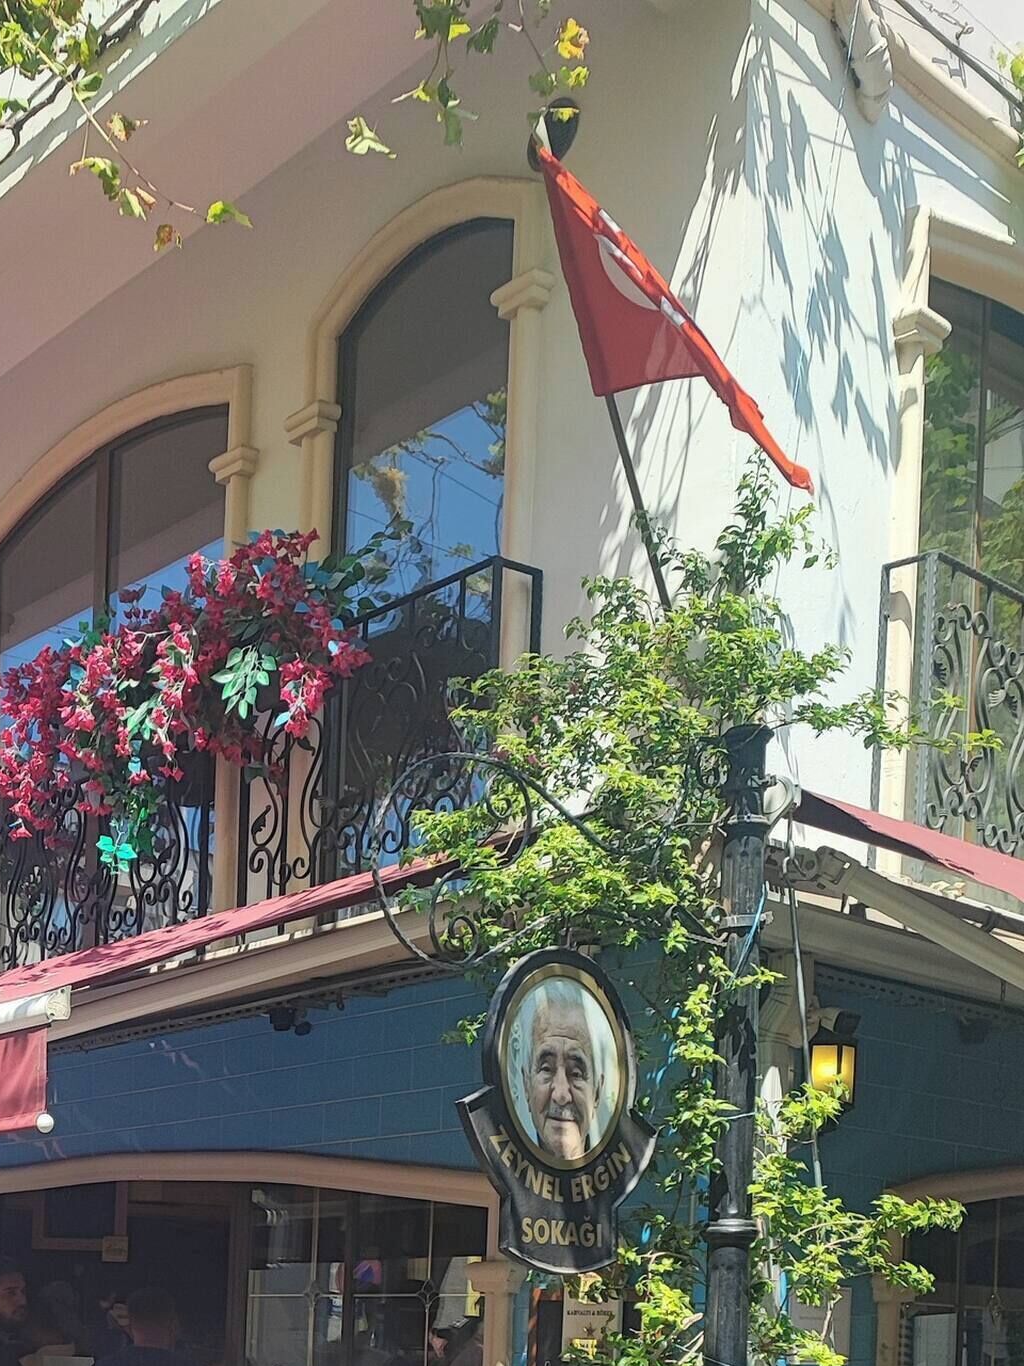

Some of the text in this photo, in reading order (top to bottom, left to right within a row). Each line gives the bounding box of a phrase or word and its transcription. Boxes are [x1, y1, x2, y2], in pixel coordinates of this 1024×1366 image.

[489, 1124, 632, 1202] ZEYNEL ERGİN
[521, 1215, 603, 1248] SOKAĞI
